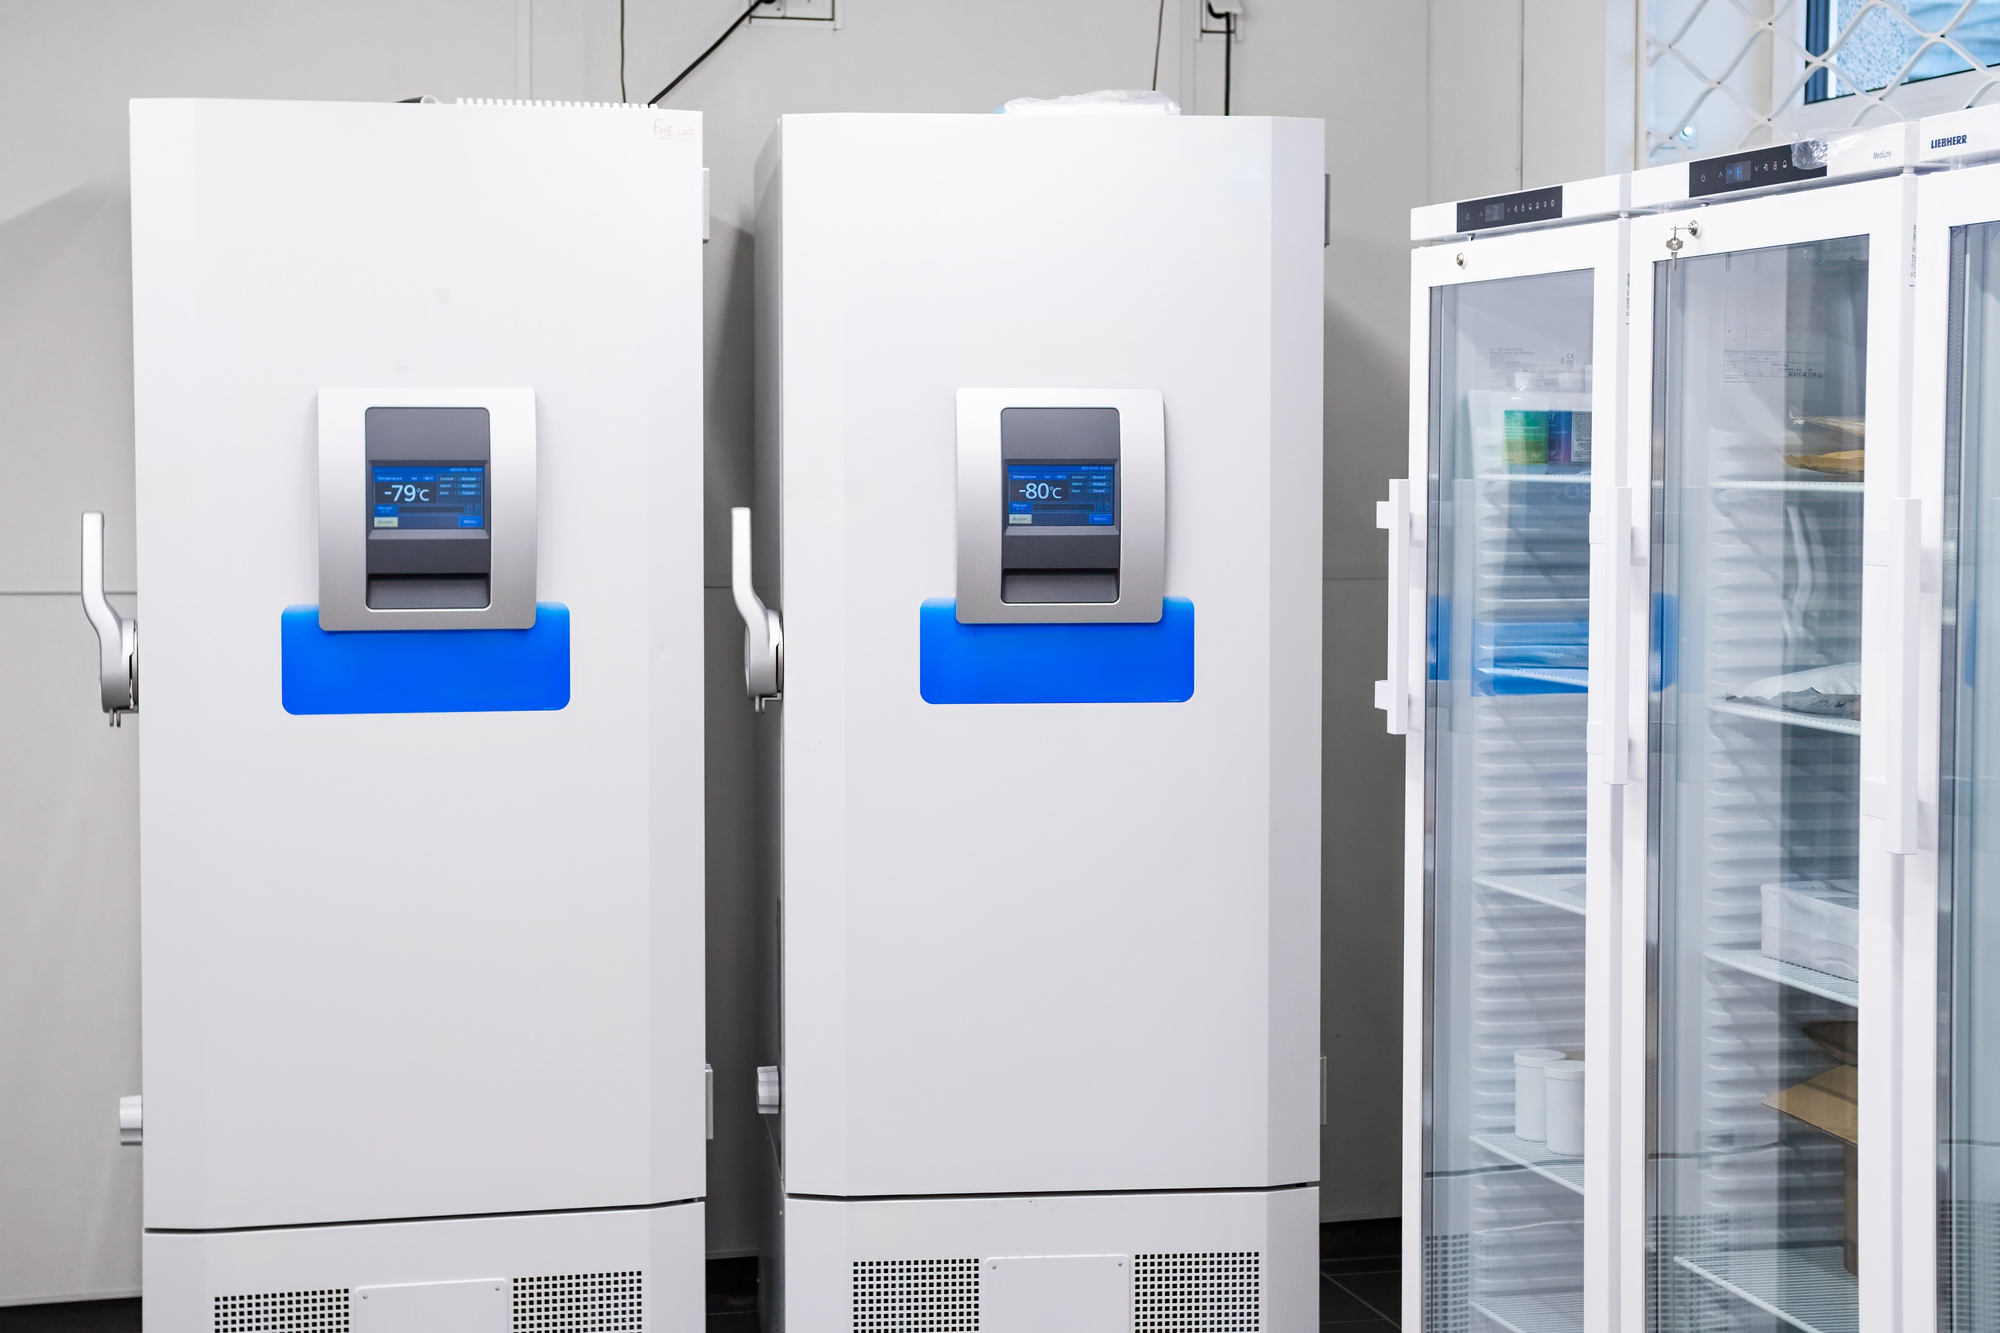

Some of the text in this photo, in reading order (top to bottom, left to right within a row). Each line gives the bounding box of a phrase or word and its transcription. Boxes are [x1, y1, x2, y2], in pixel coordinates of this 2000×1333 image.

[677, 125, 696, 136] Lab
[1930, 134, 1968, 149] LIEBHERR
[384, 484, 429, 502] -79°C
[1019, 482, 1062, 500] -80°C
